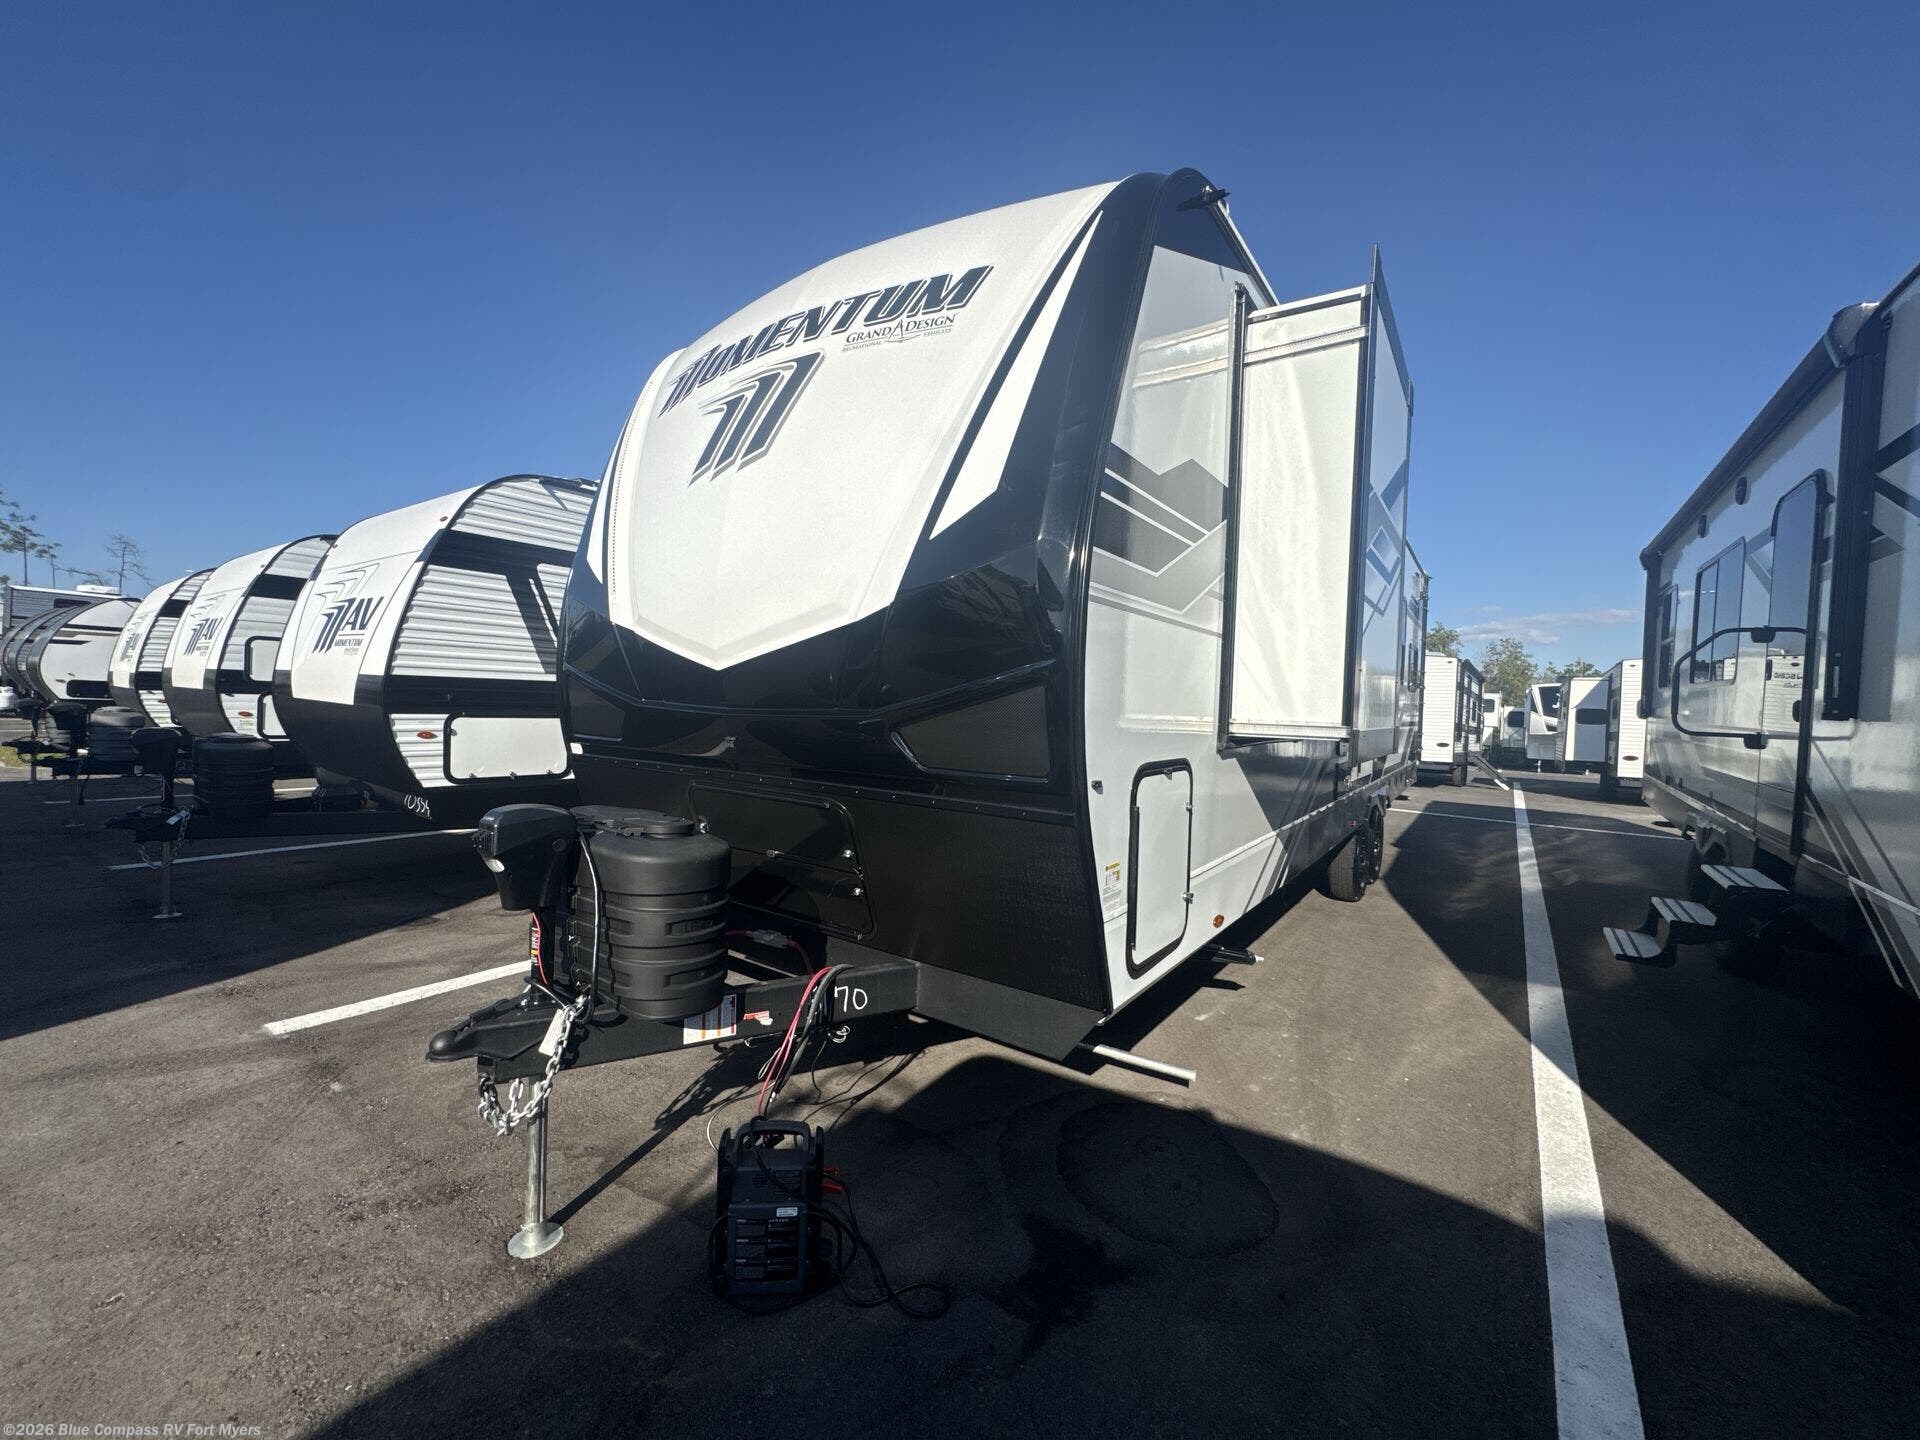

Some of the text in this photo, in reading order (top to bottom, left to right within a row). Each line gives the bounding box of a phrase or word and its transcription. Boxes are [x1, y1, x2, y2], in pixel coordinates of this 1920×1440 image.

[657, 264, 994, 419] MOMENTUM
[846, 314, 956, 344] GRAND DESIGN
